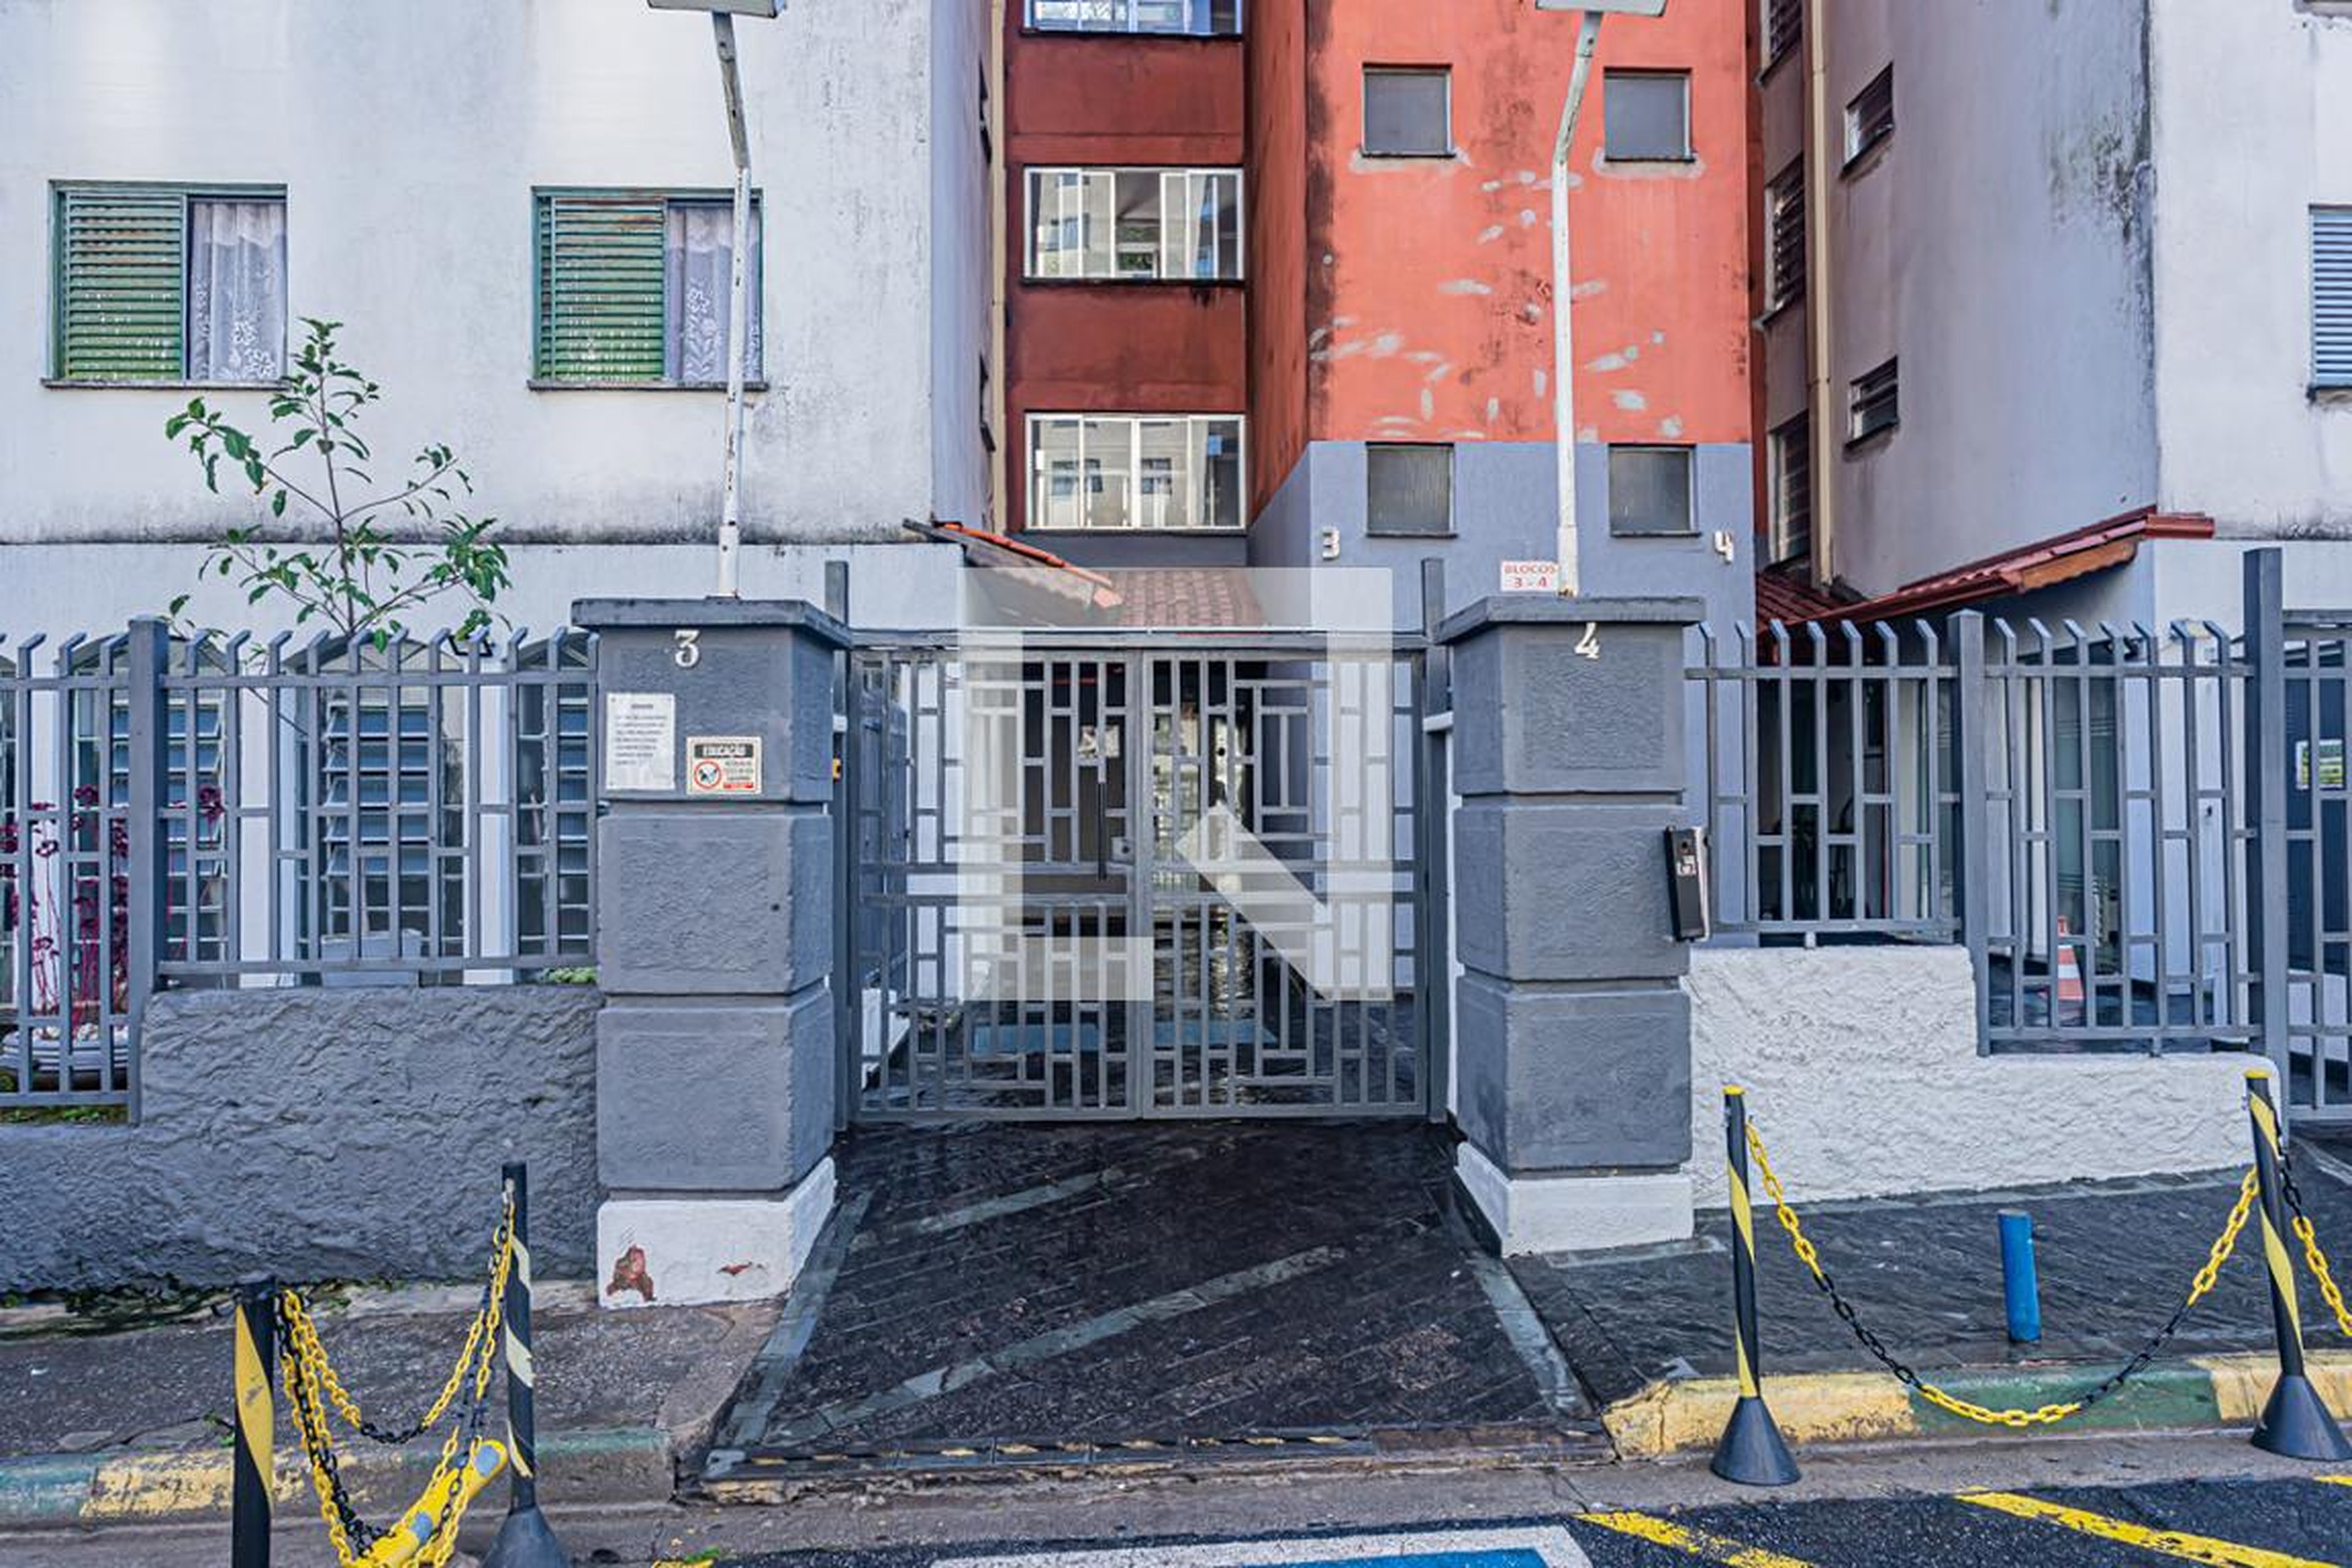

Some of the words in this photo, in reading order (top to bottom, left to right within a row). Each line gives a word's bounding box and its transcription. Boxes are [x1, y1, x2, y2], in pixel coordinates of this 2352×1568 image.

[1322, 527, 1340, 558] 3
[1715, 530, 1733, 562] 4
[1504, 564, 1555, 575] BLOCOS
[674, 629, 699, 667] 3
[1574, 622, 1600, 660] 4
